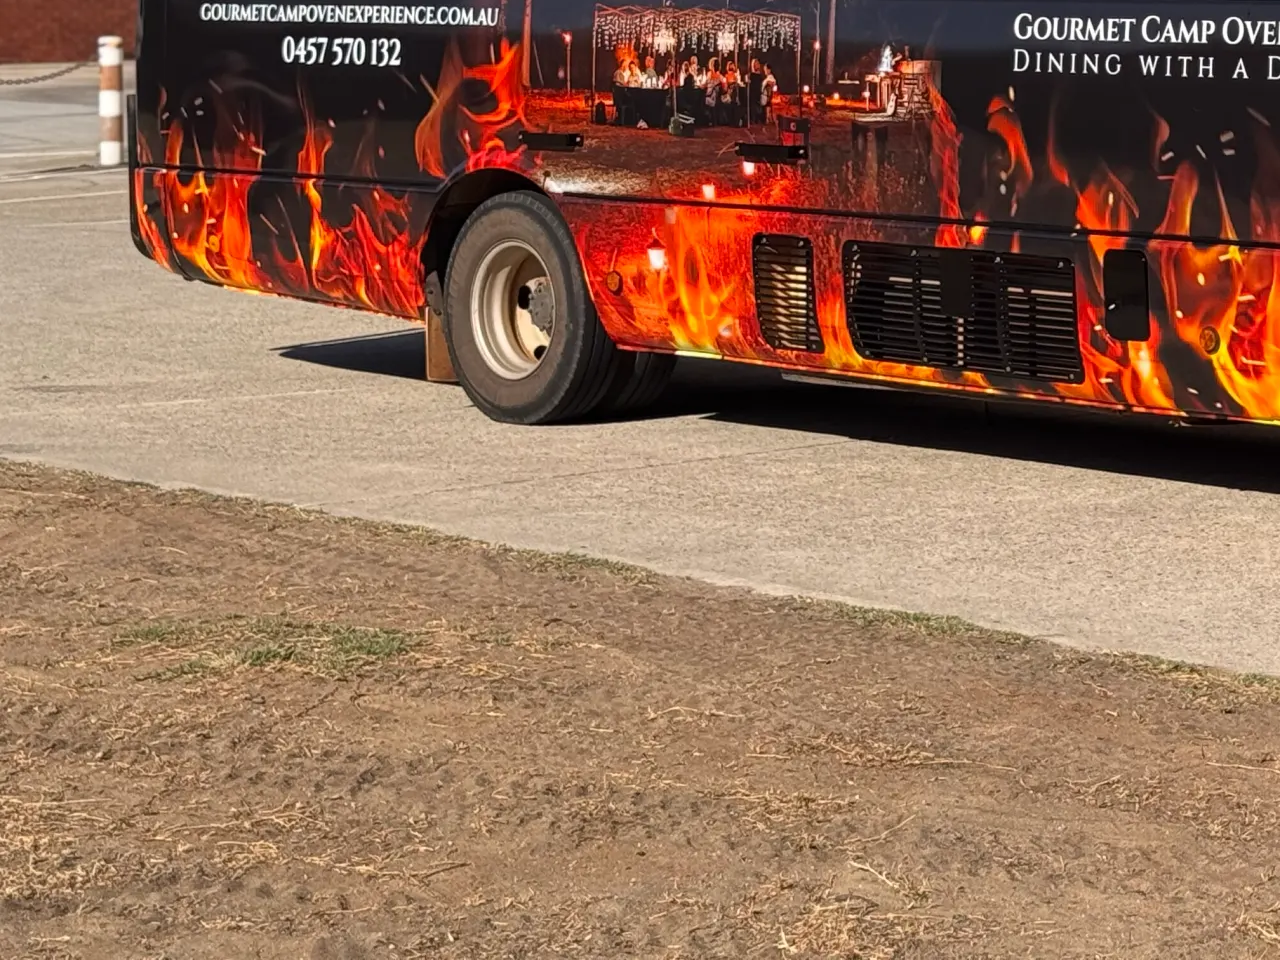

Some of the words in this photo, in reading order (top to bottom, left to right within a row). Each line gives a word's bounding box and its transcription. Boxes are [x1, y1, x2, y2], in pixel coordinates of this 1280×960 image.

[200, 2, 500, 28] GOURMETCAMPOVENEXPERIENCE.COM.AU
[1013, 12, 1137, 42] GOURMET
[1141, 15, 1216, 44] CAMP
[282, 35, 328, 65] 0457
[331, 37, 366, 66] 570
[370, 37, 401, 67] 132
[1013, 48, 1122, 75] DINING
[1138, 54, 1214, 78] WITH
[1232, 57, 1249, 79] A
